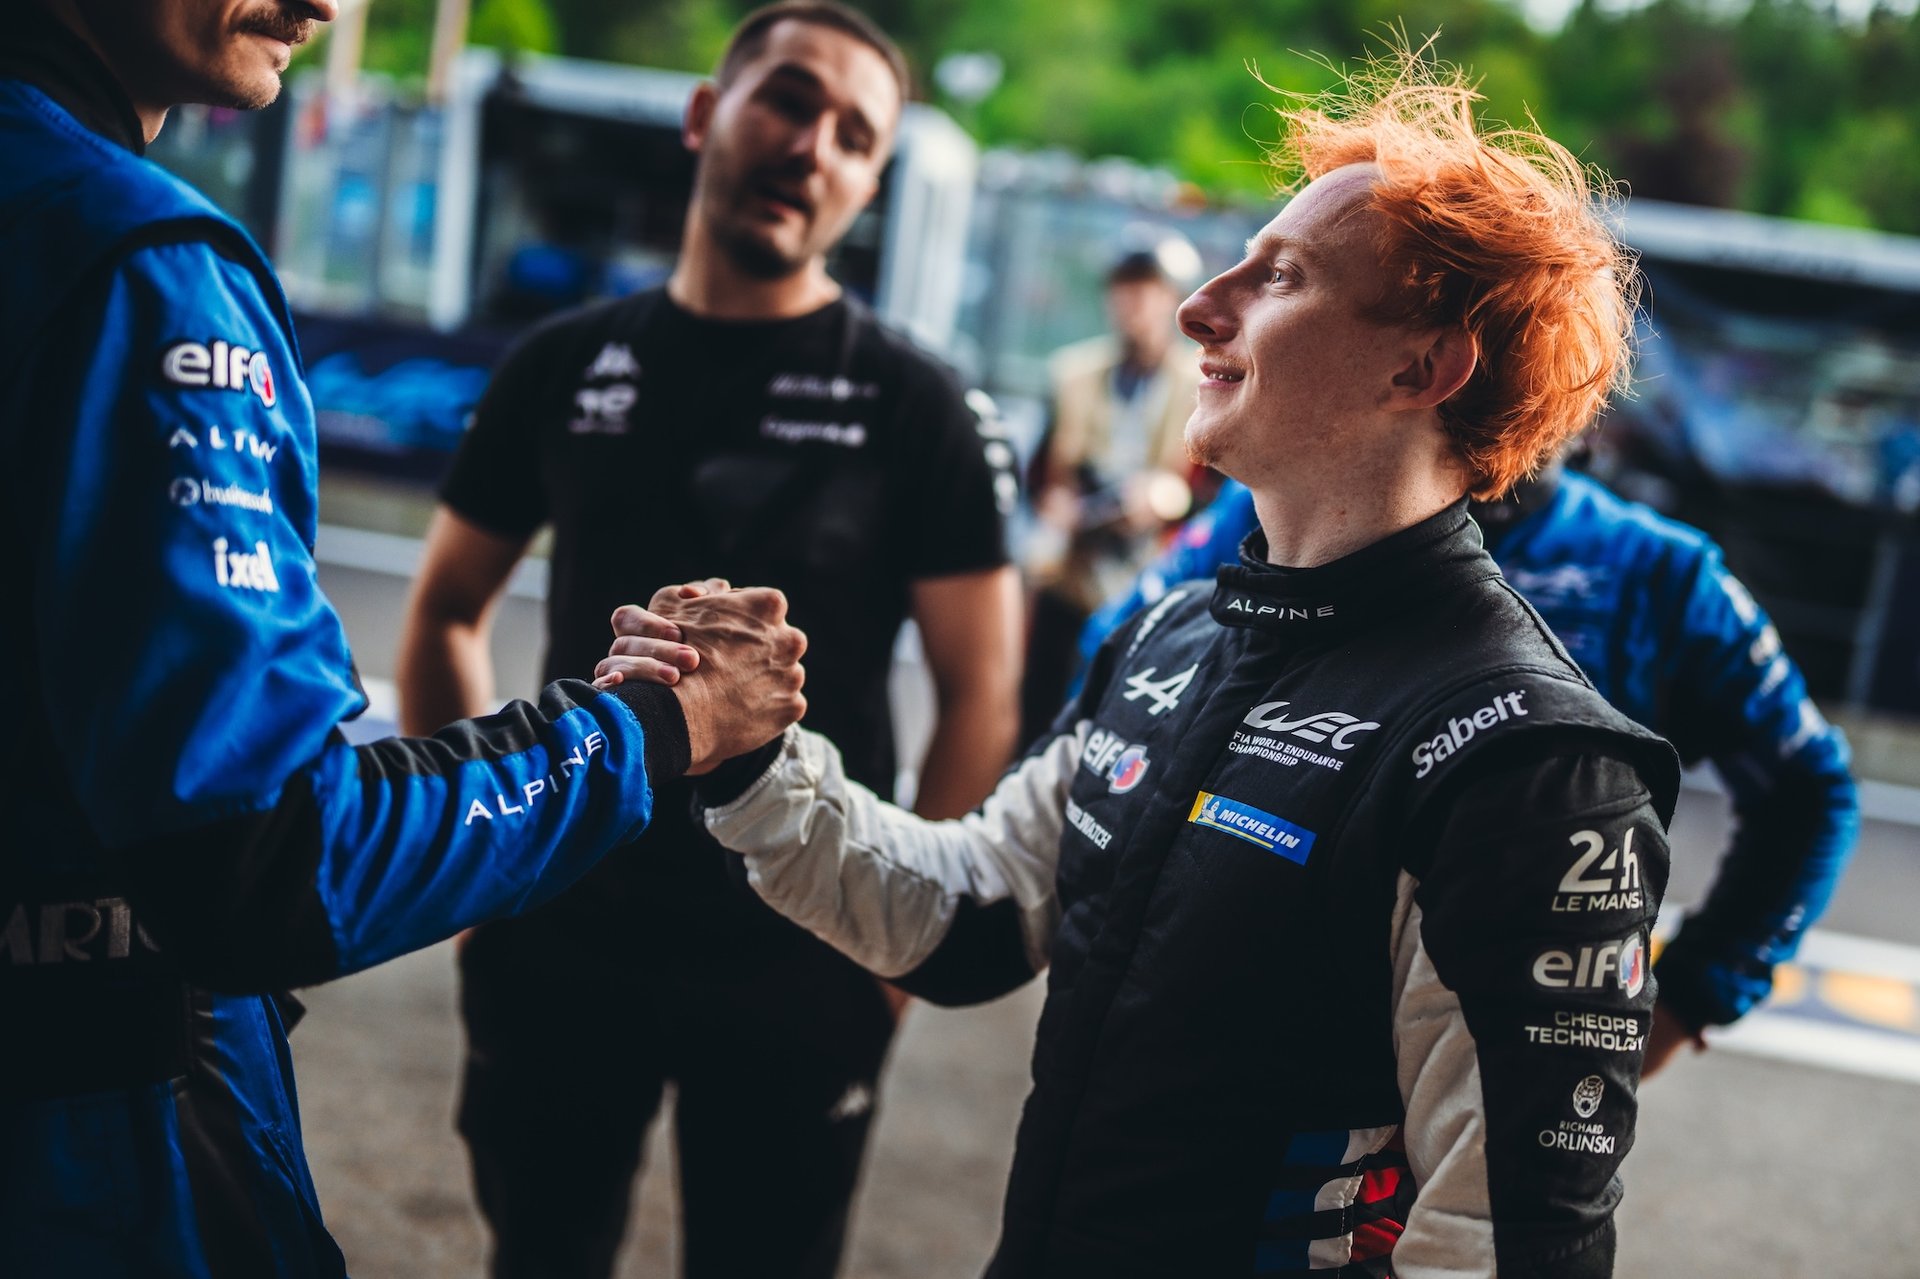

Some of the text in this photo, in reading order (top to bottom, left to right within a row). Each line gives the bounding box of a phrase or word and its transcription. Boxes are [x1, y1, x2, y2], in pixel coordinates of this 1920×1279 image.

[163, 340, 251, 391] elf
[1227, 599, 1335, 620] ALPINE
[1243, 701, 1381, 750] WEC
[1412, 690, 1528, 779] Sabelt
[1082, 728, 1127, 772] elf
[1228, 741, 1299, 767] CHAMPIONSHIP
[1233, 731, 1344, 771] FIA WORLD ENDURANCE
[464, 731, 602, 826] ALPINE
[1218, 809, 1301, 849] MICHELIN
[1558, 827, 1639, 892] 24h
[1551, 891, 1640, 912] LE MANS
[1532, 945, 1619, 988] elf
[1554, 1011, 1639, 1036] CHEOPS
[1538, 1130, 1616, 1154] ORLINSKI
[1559, 1120, 1604, 1135] RICHARD
